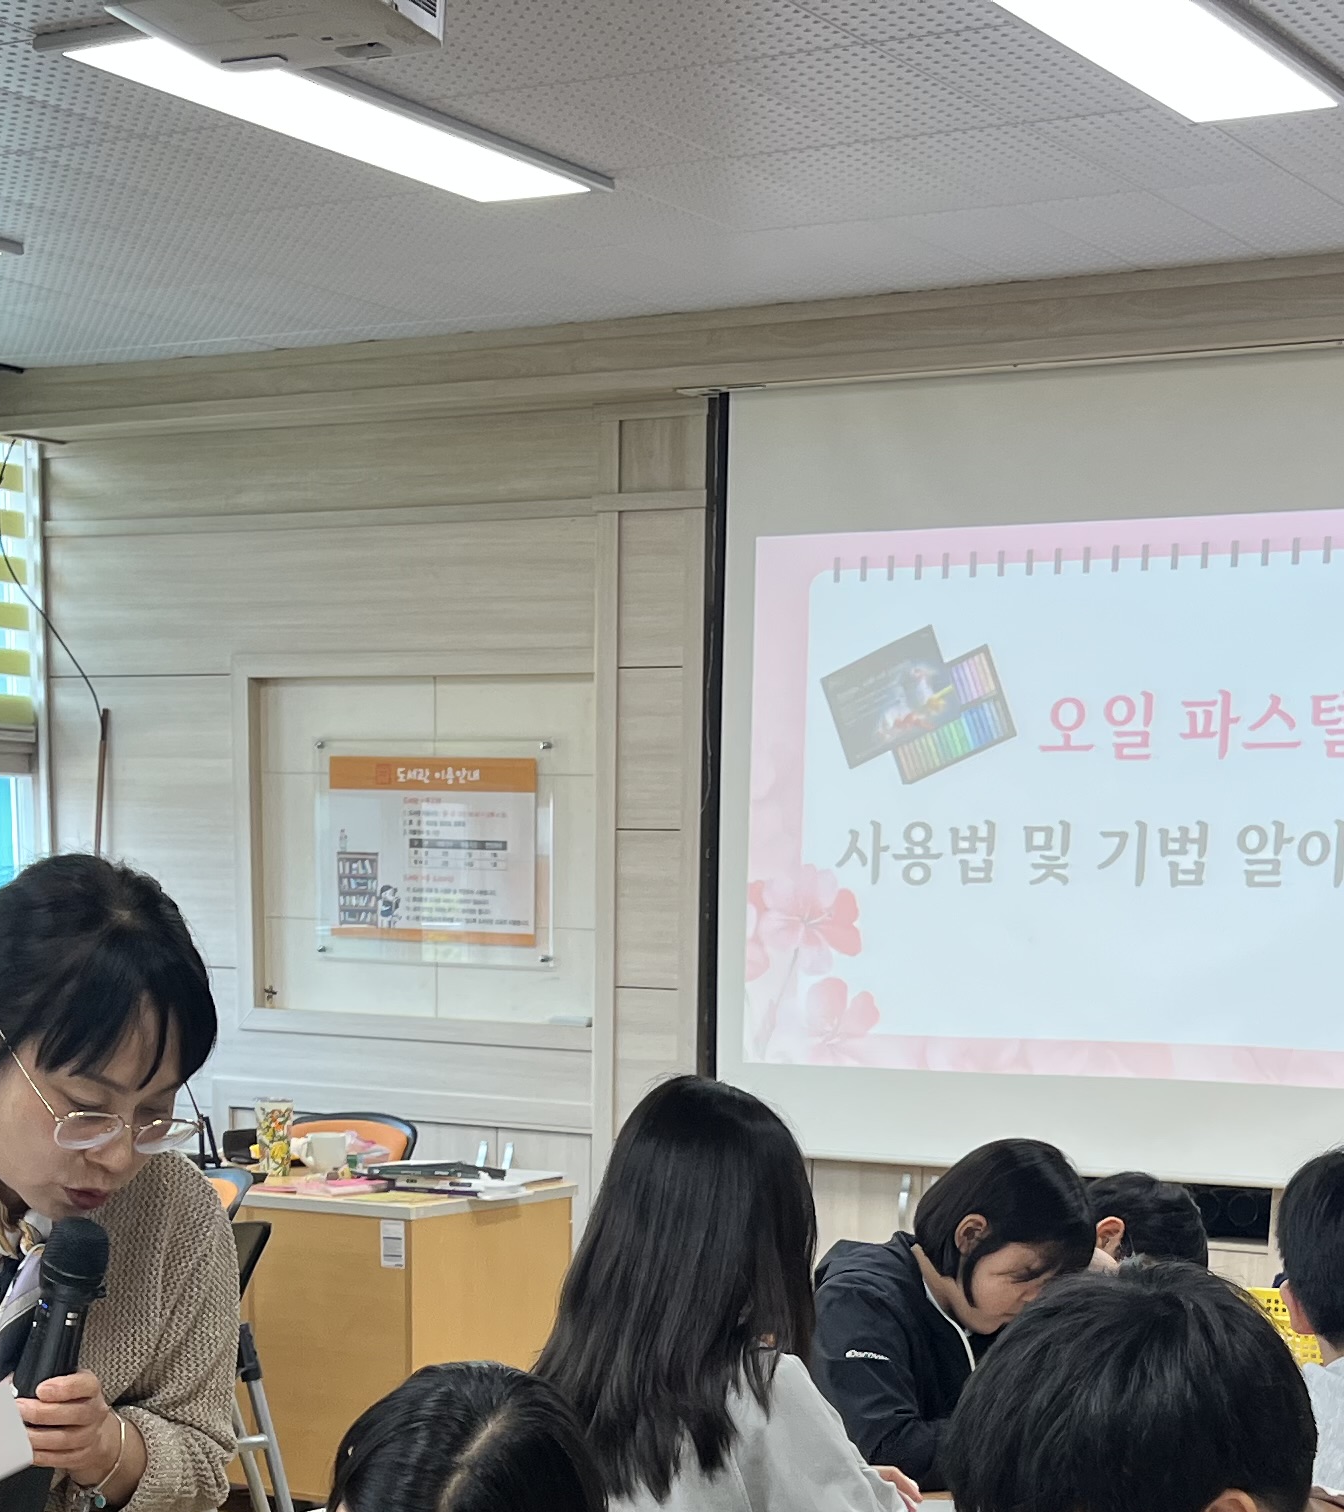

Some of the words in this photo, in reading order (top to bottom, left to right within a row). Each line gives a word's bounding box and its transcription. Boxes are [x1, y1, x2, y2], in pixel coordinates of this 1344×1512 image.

[1038, 690, 1156, 762] 오일
[835, 819, 999, 887] 사용법
[1023, 819, 1072, 887] 및
[1096, 819, 1209, 889] 기법
